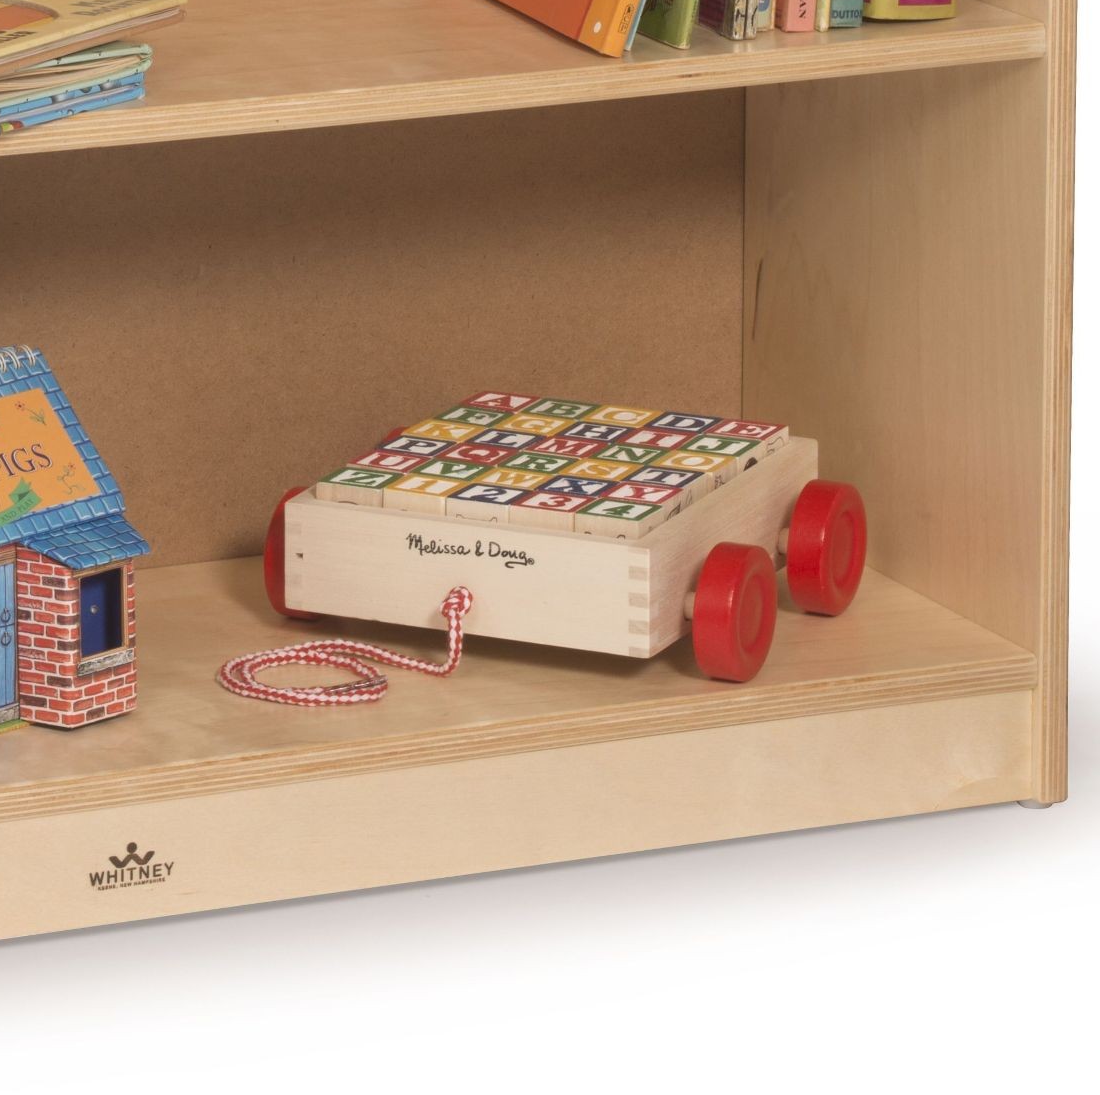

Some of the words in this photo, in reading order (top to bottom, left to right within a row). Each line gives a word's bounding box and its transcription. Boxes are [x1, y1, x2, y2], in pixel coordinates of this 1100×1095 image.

[458, 409, 495, 425] F
[512, 415, 558, 433] G
[575, 424, 619, 439] H
[651, 432, 678, 445] I
[697, 439, 740, 452] J
[474, 393, 518, 407] A
[545, 403, 592, 416] B
[602, 407, 638, 421] C
[665, 415, 706, 429] D
[723, 421, 767, 434] E
[393, 440, 438, 452] P
[458, 445, 499, 462] Q
[517, 456, 560, 470] R
[582, 462, 613, 478] S
[643, 469, 688, 482] T
[425, 423, 469, 437] K
[481, 432, 518, 445] L
[538, 438, 593, 454] M
[606, 447, 647, 462] N
[668, 454, 715, 469] O
[339, 472, 383, 484] Z
[410, 480, 433, 493] 1
[470, 488, 508, 502] 2
[533, 496, 574, 507] 3
[602, 505, 634, 515] 4
[369, 454, 411, 468] U
[435, 462, 481, 476] V
[496, 472, 540, 486] W
[561, 479, 599, 493] X
[630, 487, 669, 500] Y
[406, 533, 471, 556] Melissa
[474, 540, 485, 557] &
[89, 861, 175, 887] WHITNEY
